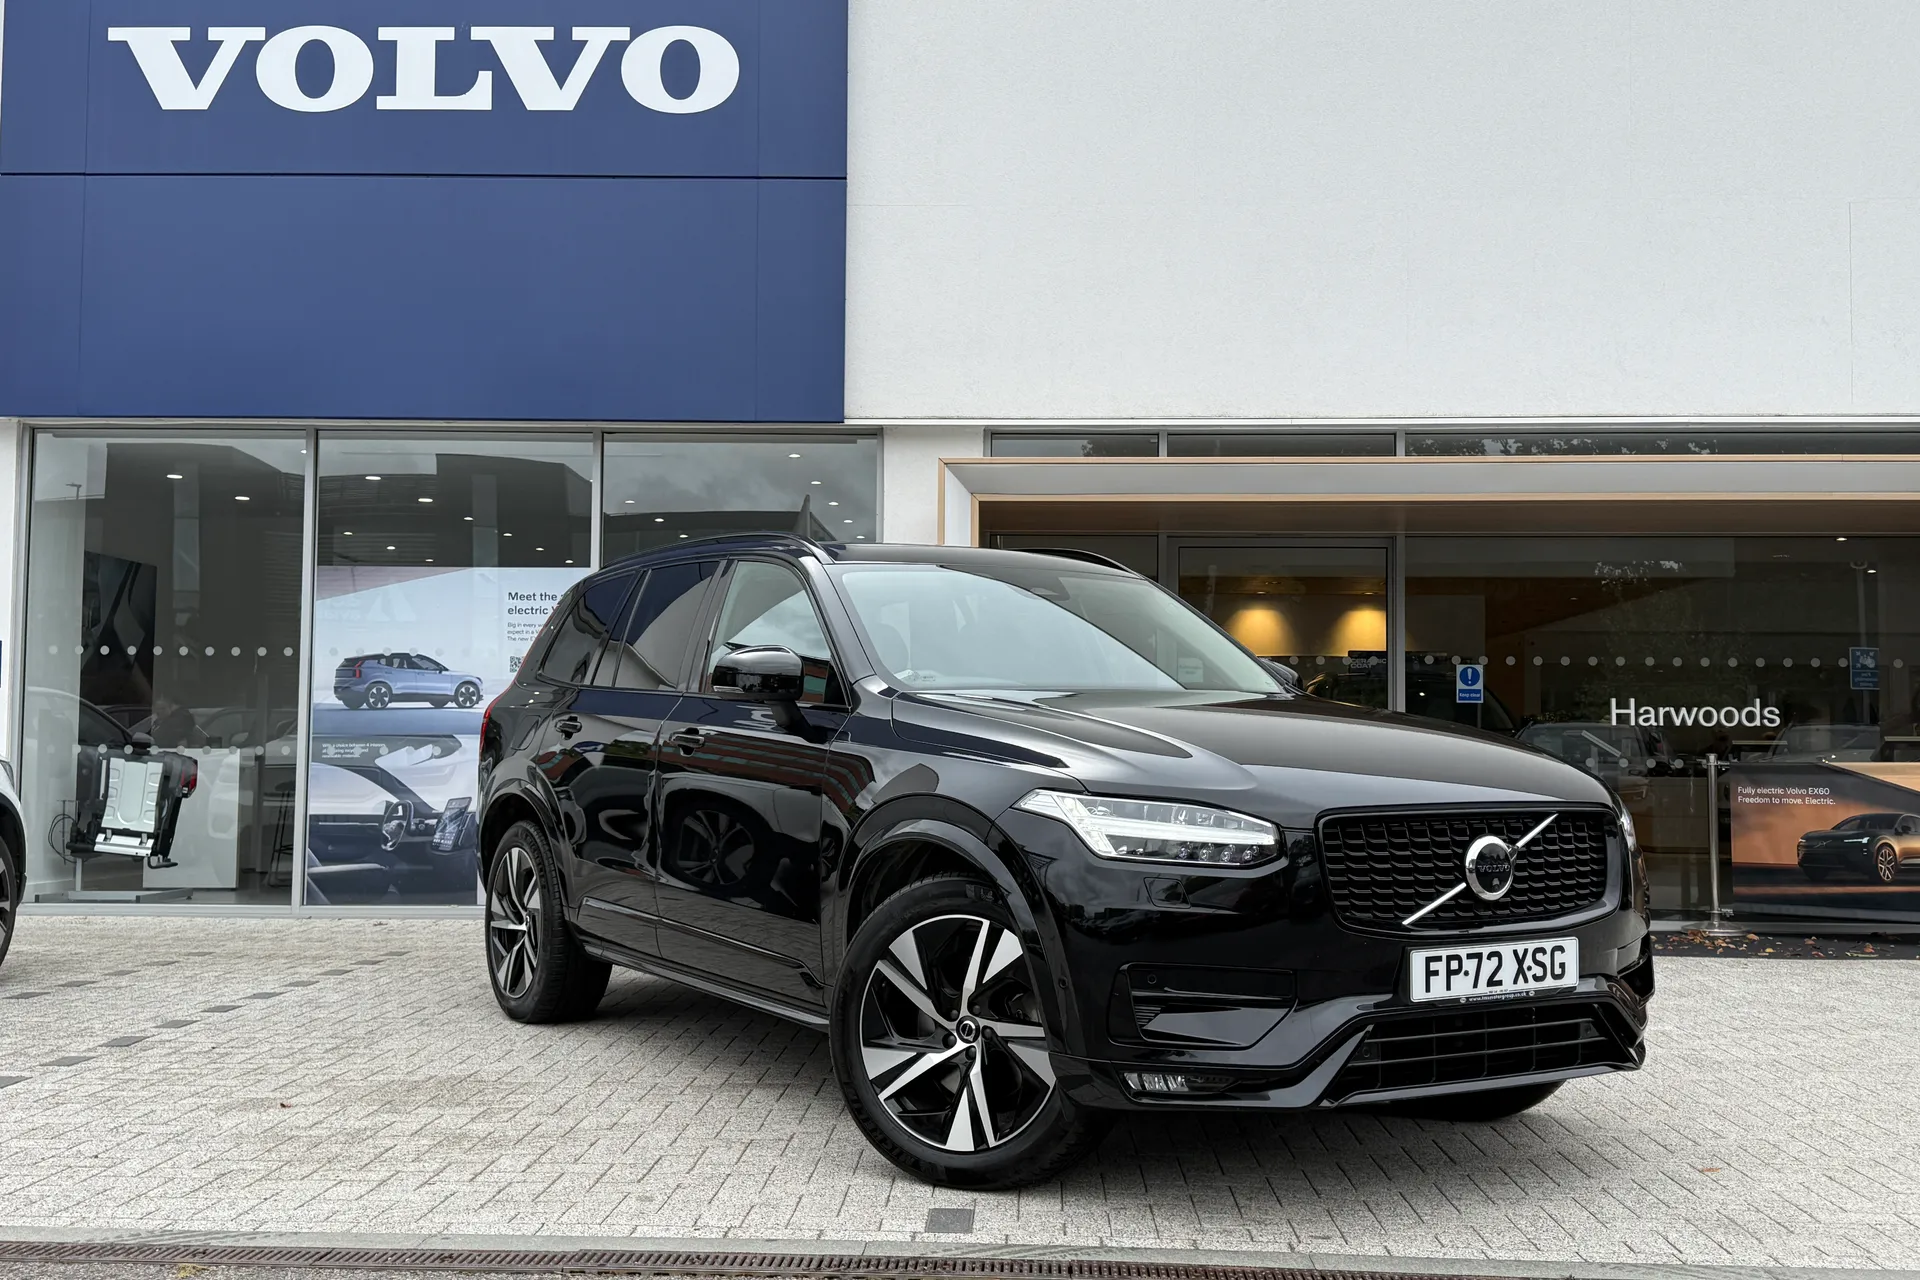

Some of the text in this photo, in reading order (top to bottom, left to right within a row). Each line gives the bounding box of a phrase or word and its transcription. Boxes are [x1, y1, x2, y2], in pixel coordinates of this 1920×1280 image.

[107, 25, 740, 114] VOLVO
[507, 592, 537, 601] Meet
[539, 592, 558, 601] the
[507, 606, 549, 615] electric
[1610, 697, 1781, 727] Harwoods
[1738, 786, 1830, 796] Fully electric Volvo EX60
[1738, 796, 1771, 804] Freedom
[1772, 796, 1780, 804] to
[1805, 797, 1836, 805] Electric.
[1478, 864, 1511, 873] VOLVO
